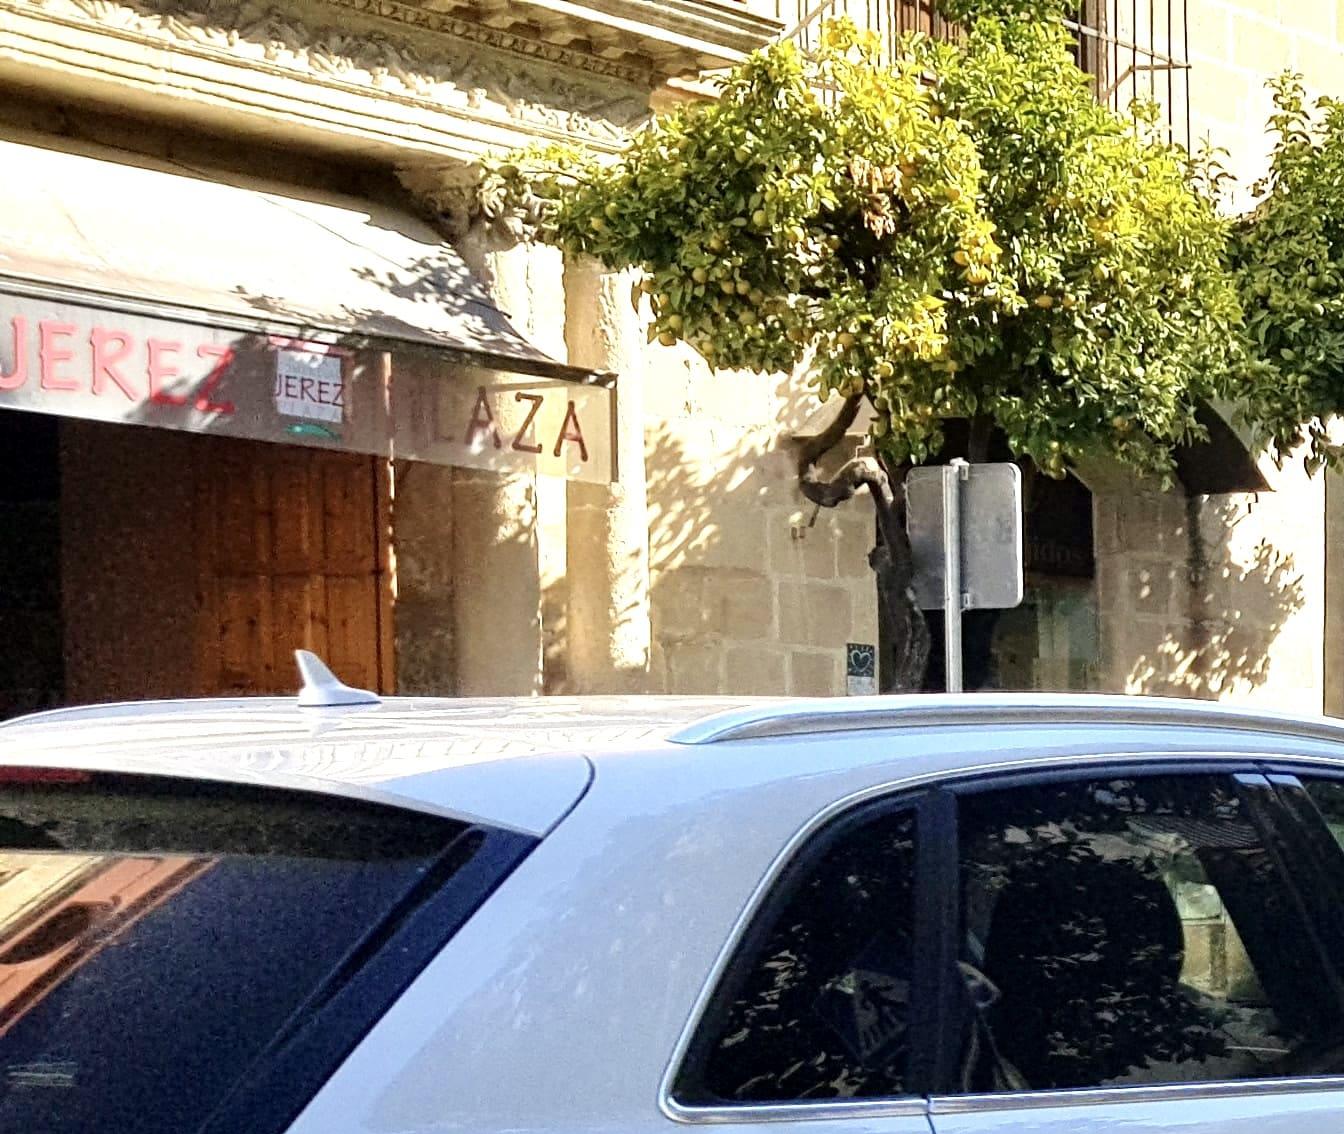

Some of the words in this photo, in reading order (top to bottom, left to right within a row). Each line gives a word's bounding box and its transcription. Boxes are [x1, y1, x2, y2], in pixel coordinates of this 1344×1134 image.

[0, 314, 236, 413] JEREZ
[275, 374, 346, 407] JEREZ
[410, 373, 589, 462] LAZA
